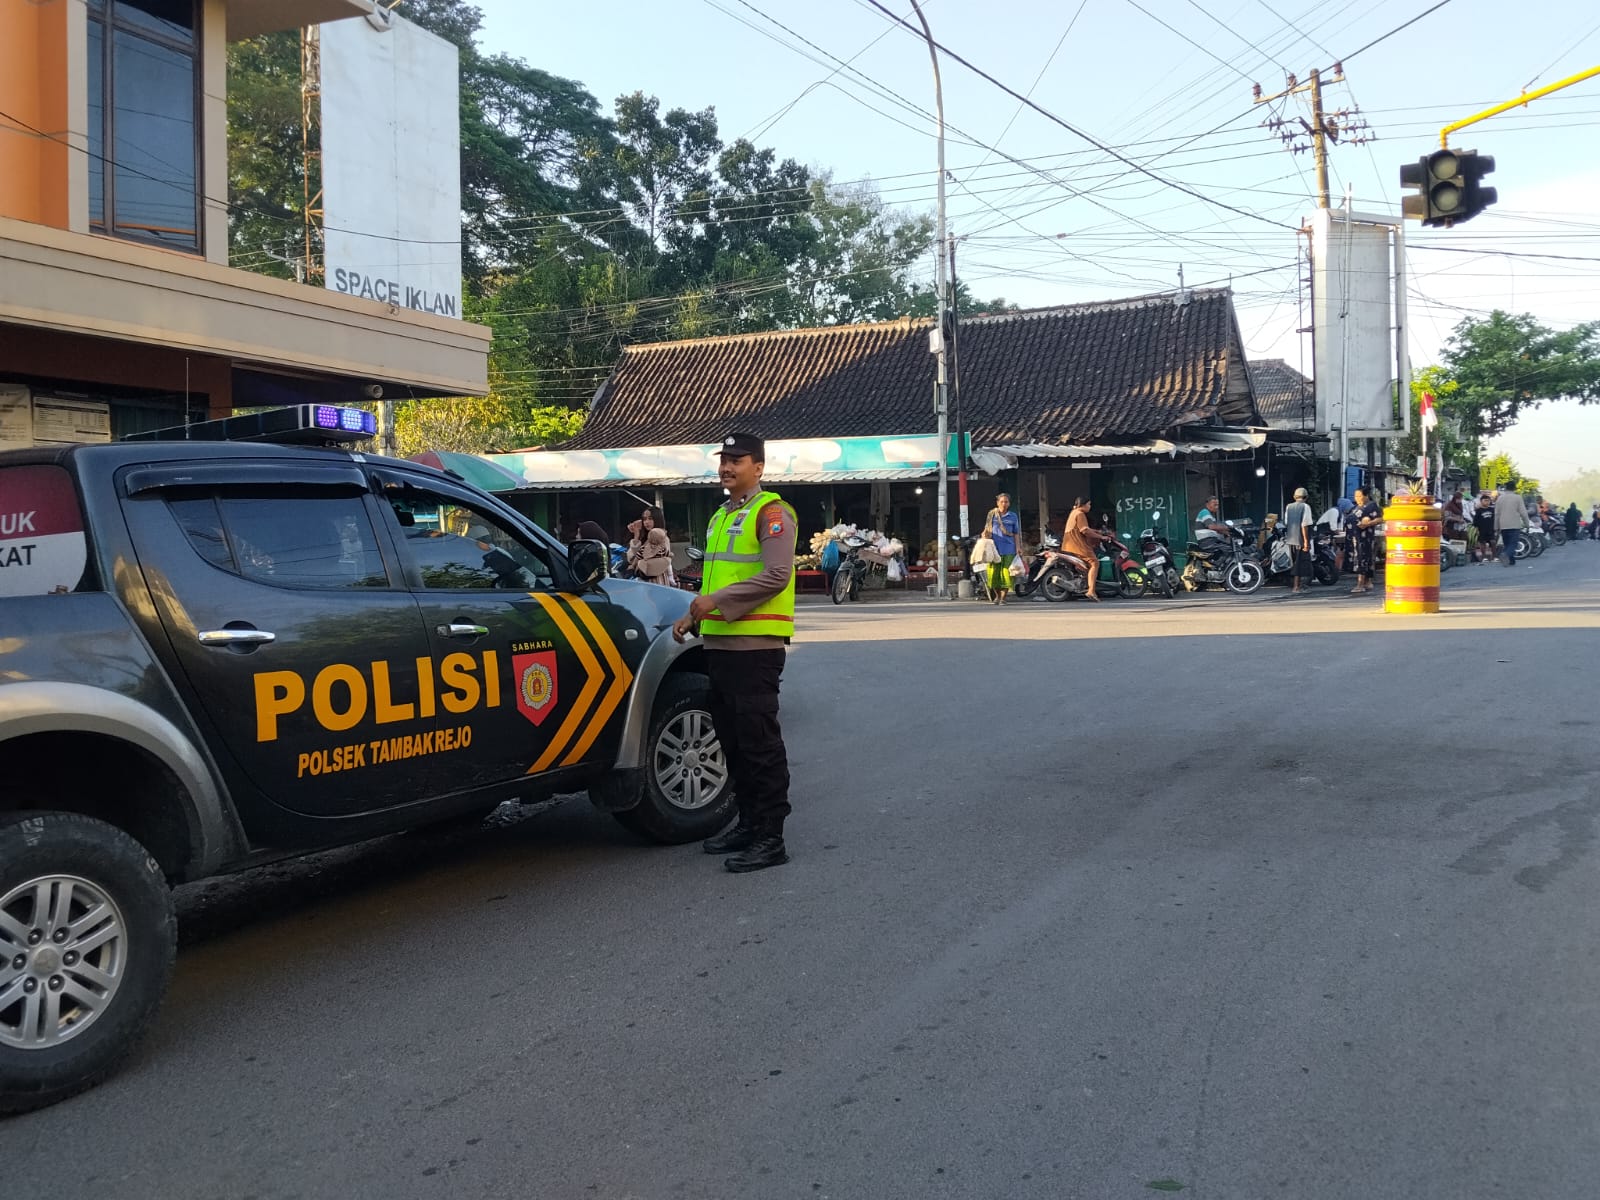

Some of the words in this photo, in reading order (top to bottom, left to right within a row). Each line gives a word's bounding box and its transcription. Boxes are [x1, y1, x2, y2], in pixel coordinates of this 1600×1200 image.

[335, 267, 400, 305] SPACE
[405, 285, 456, 317] IKLAN
[0, 510, 37, 535] UK
[1115, 495, 1174, 515] 654321
[511, 640, 553, 652] SABHARA
[253, 650, 500, 742] POLISI
[297, 744, 366, 778] POLSEK
[370, 725, 472, 765] TAMBAKREJO
